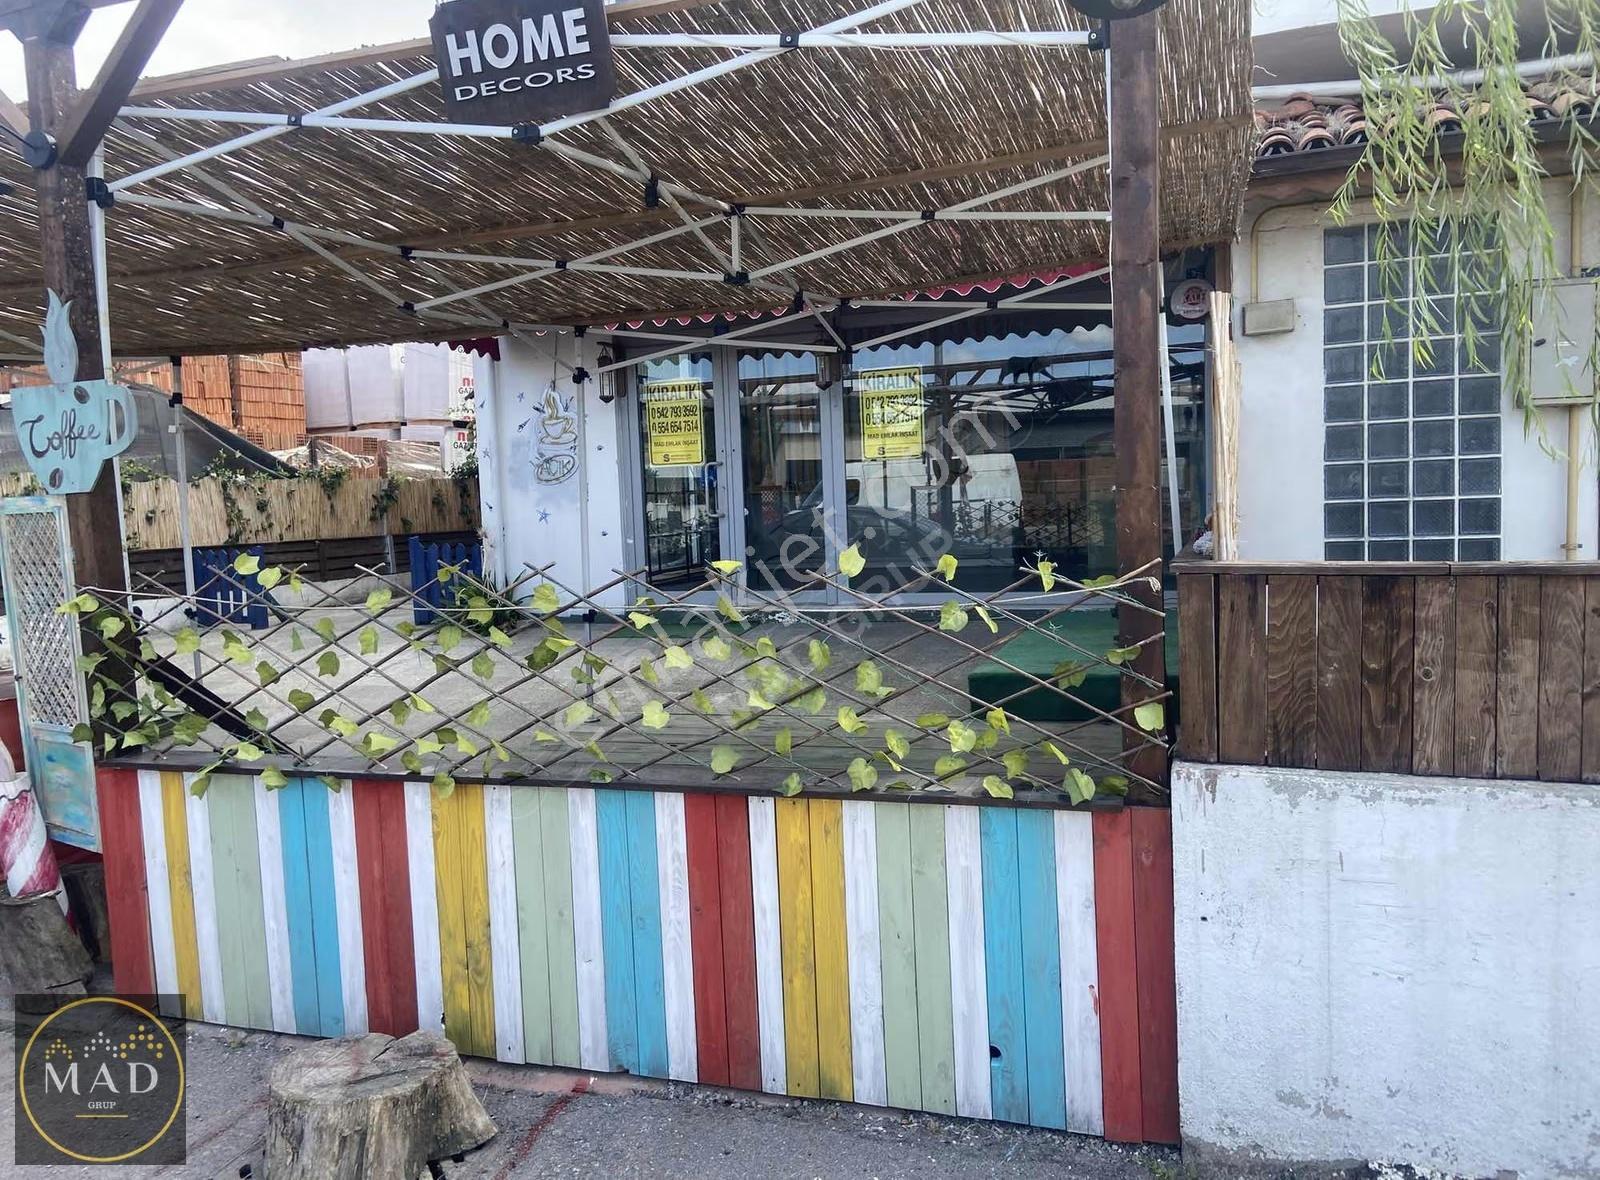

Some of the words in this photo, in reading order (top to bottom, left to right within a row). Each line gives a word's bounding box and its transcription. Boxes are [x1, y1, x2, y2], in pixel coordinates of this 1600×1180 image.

[445, 7, 591, 77] HOME
[454, 63, 596, 101] DECORS
[20, 408, 101, 460] Coffee
